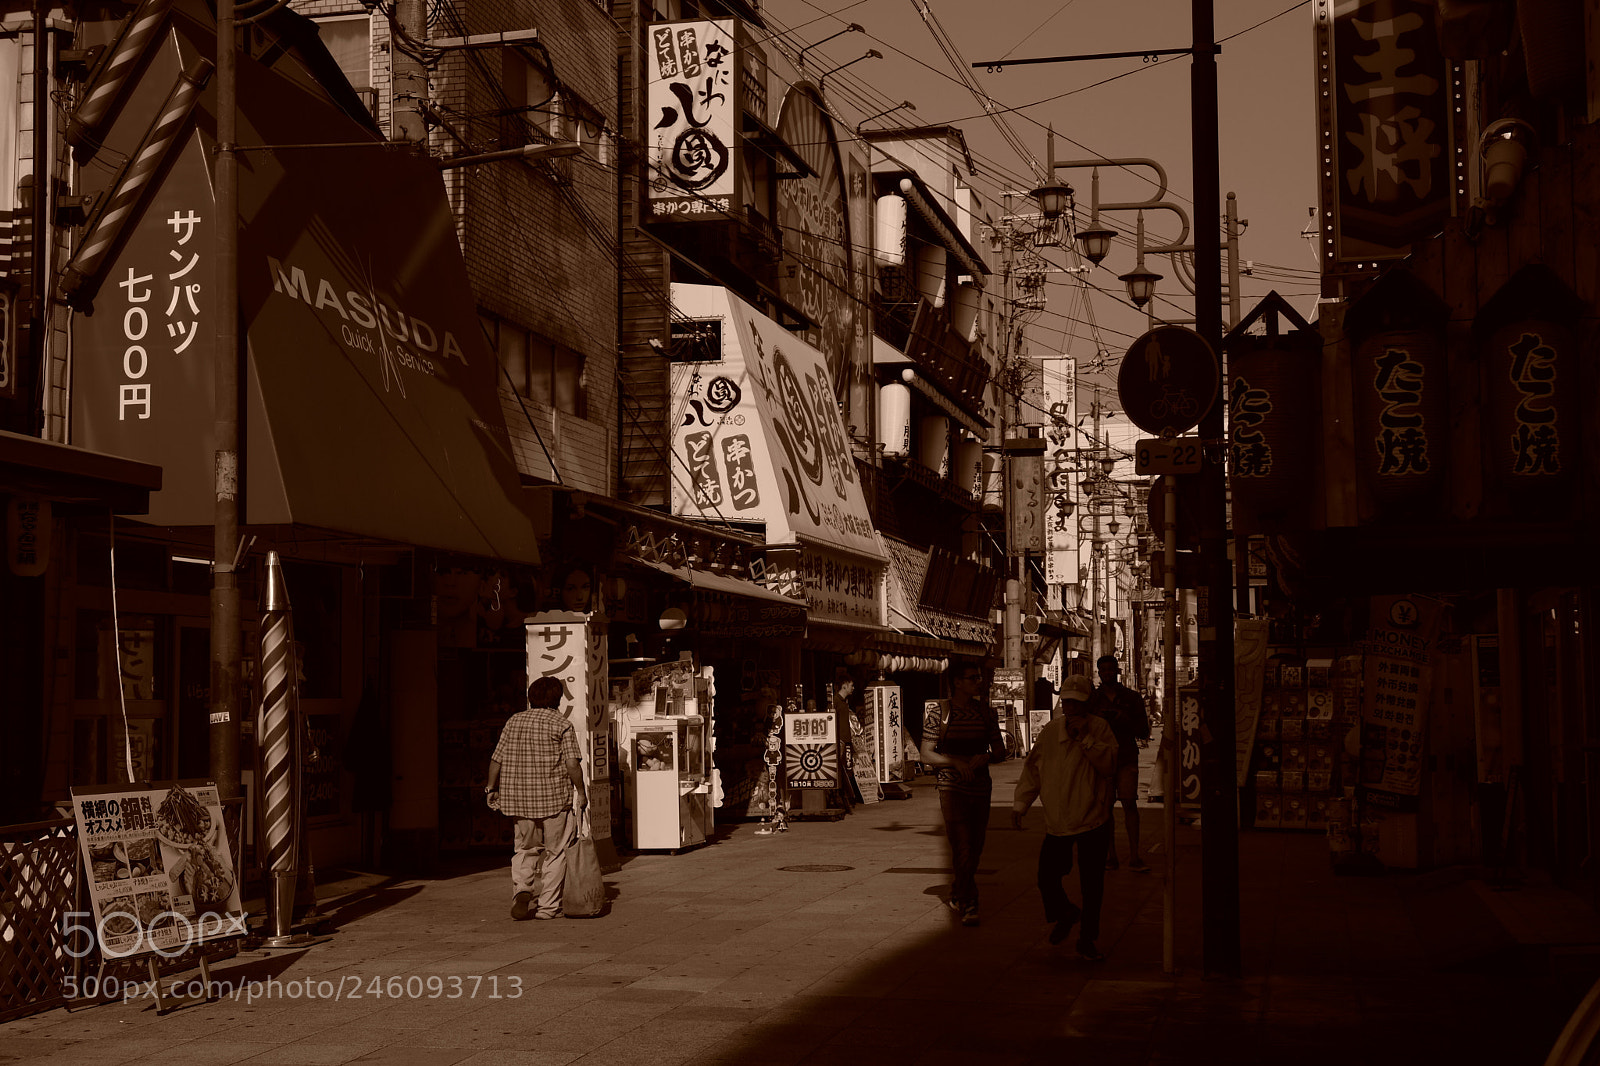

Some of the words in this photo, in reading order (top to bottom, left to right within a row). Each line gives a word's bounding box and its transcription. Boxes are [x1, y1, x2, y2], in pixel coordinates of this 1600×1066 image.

[680, 30, 700, 76] 串かつ
[698, 40, 729, 110] なにわ
[1343, 12, 1442, 203] 王将
[166, 209, 202, 355] サンパツ
[266, 255, 470, 367] MASUDA
[341, 324, 376, 355] Quick
[396, 344, 435, 376] Service
[1230, 376, 1273, 478] たこ焼
[1375, 350, 1431, 475] たこ焼
[1508, 333, 1562, 475] たこ焼
[688, 434, 721, 506] どて焼
[726, 438, 756, 505] 串かつ
[1139, 445, 1197, 468] 9-22
[1372, 643, 1429, 663] EXCHANGE
[1374, 629, 1431, 650] MONEY
[793, 719, 827, 736] 射的
[1181, 695, 1201, 800] 串かつ
[81, 799, 120, 820] 横綱の
[84, 818, 123, 835] オススメ
